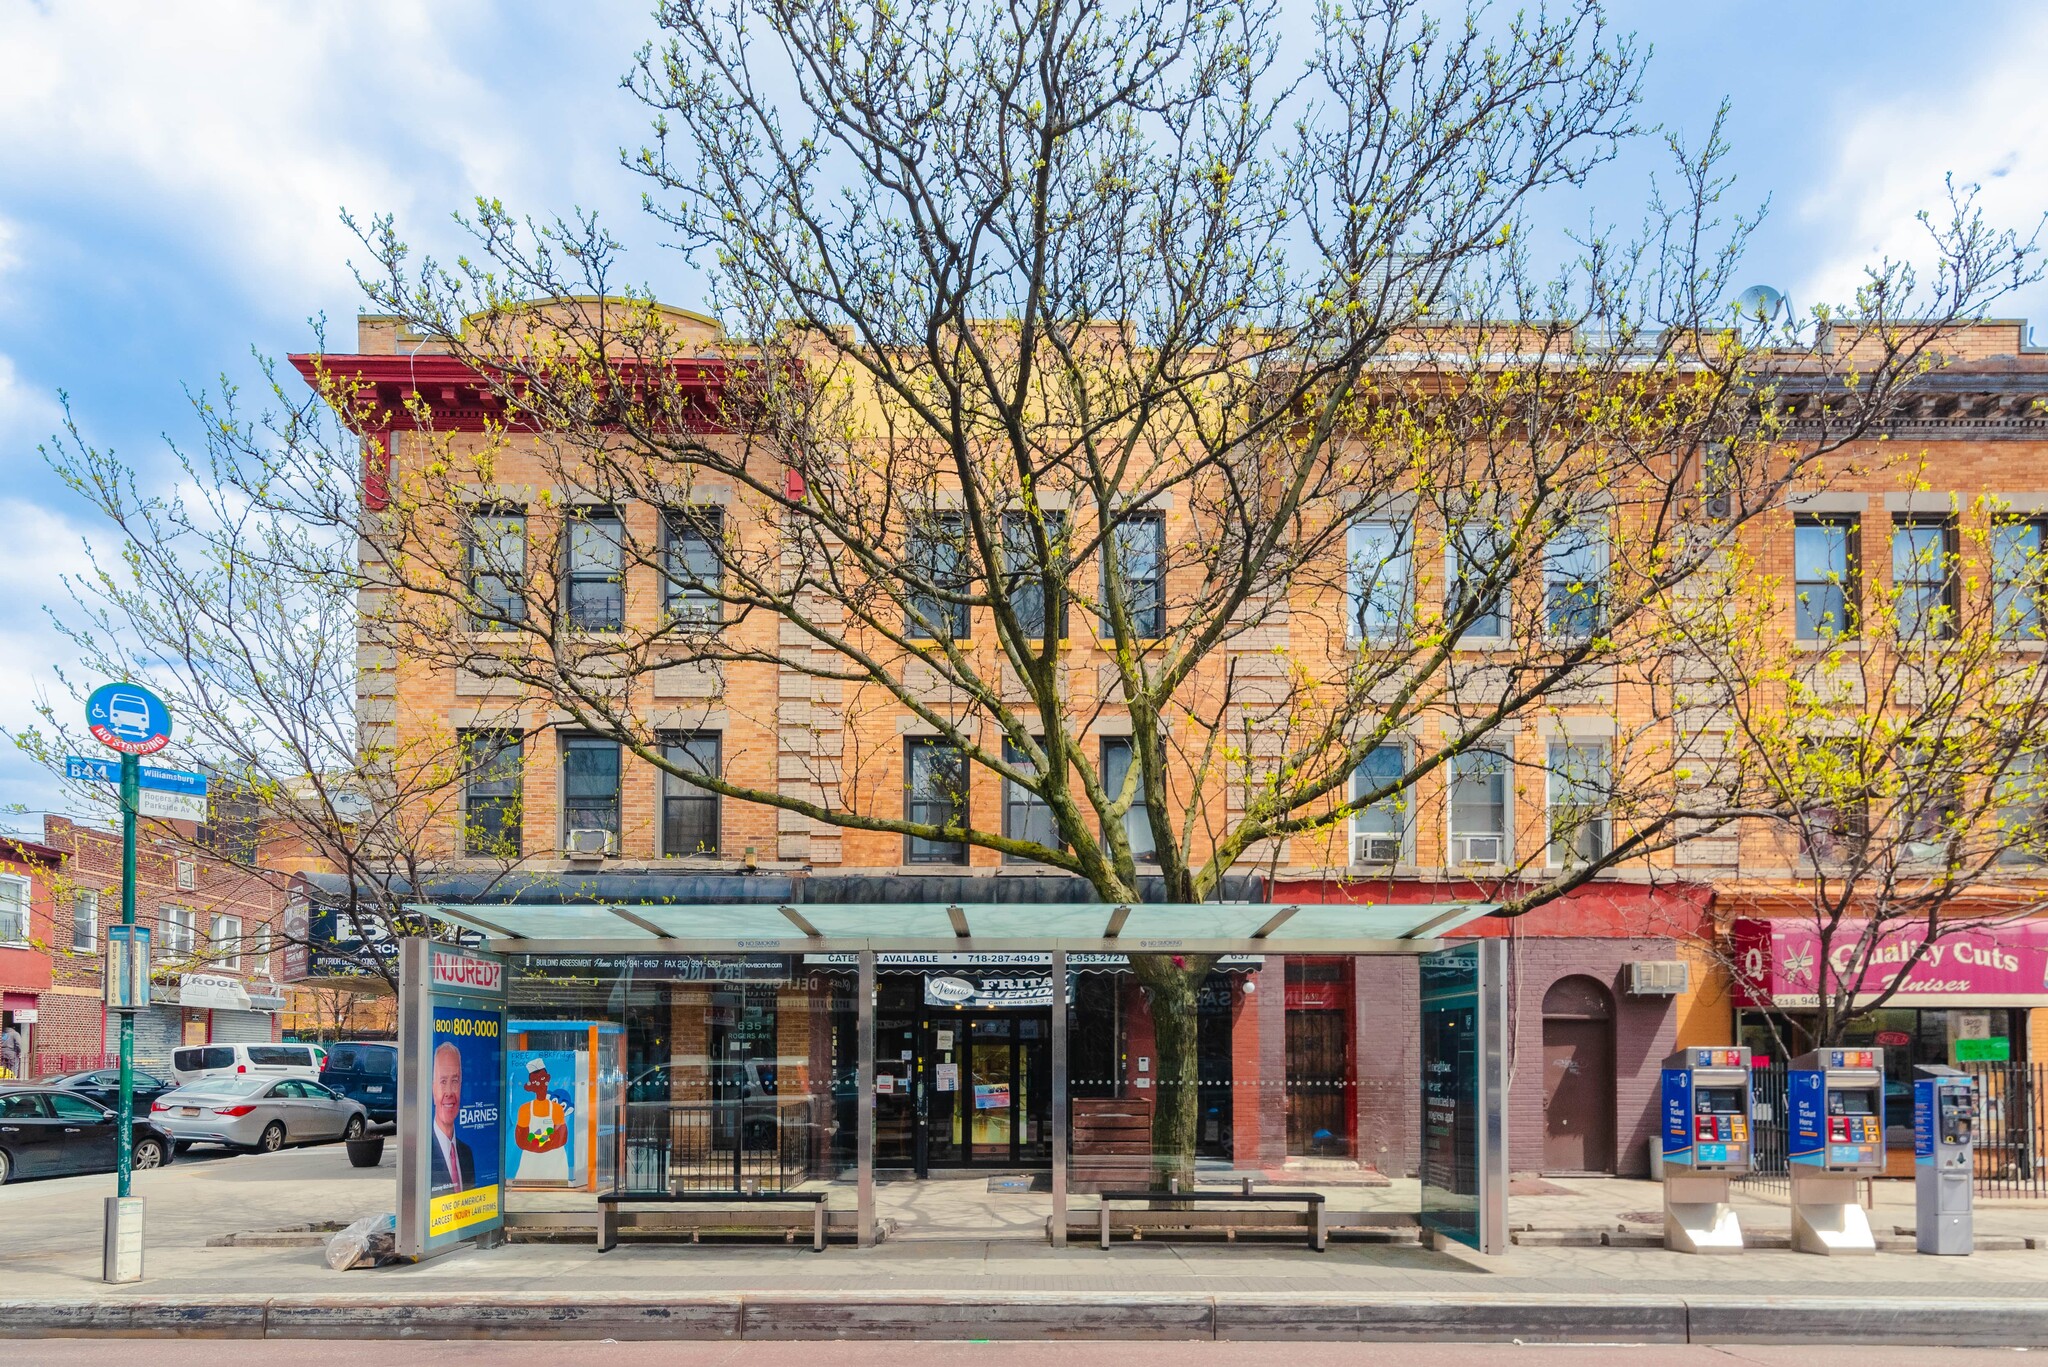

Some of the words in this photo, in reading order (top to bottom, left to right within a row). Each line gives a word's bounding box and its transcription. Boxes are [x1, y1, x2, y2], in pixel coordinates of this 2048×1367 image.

[95, 727, 112, 741] NO
[112, 736, 165, 753] STANDING
[71, 763, 109, 781] B44
[143, 768, 195, 785] Williamsburg
[144, 792, 172, 803] Rogers
[144, 801, 178, 812] Parkside
[180, 805, 191, 813] Av
[536, 958, 559, 967] BUILDING
[559, 958, 592, 967] ASSESSMENT
[664, 959, 677, 968] FAX
[882, 954, 939, 963] AVAILABLE
[967, 954, 1041, 963] 718-287-4949
[1066, 953, 1126, 963] 6-953-2727
[1829, 940, 1946, 973] Quality
[1953, 941, 2019, 972] Cuts
[433, 952, 500, 988] INJURED?
[1745, 948, 1764, 981] Q
[932, 980, 970, 996] Venus
[981, 976, 1054, 990] FRITA
[1880, 973, 1971, 992] Unisex
[981, 987, 1054, 999] EVERYD
[433, 1017, 453, 1034] (800)
[453, 1017, 498, 1038] 800-0000
[737, 1021, 762, 1031] 635
[511, 1051, 529, 1060] FREE
[1669, 1099, 1679, 1107] Get
[1798, 1101, 1810, 1109] Get
[459, 1107, 498, 1125] BARNES
[1670, 1107, 1685, 1116] Ticket
[1798, 1109, 1817, 1118] Ticket
[441, 1201, 453, 1213] ONE
[453, 1199, 460, 1209] OF
[461, 1193, 486, 1207] AMERICA'S
[431, 1213, 453, 1228] LARGEST
[453, 1208, 471, 1221] INJURY
[471, 1206, 482, 1216] LAW
[482, 1201, 497, 1214] FIRMS
